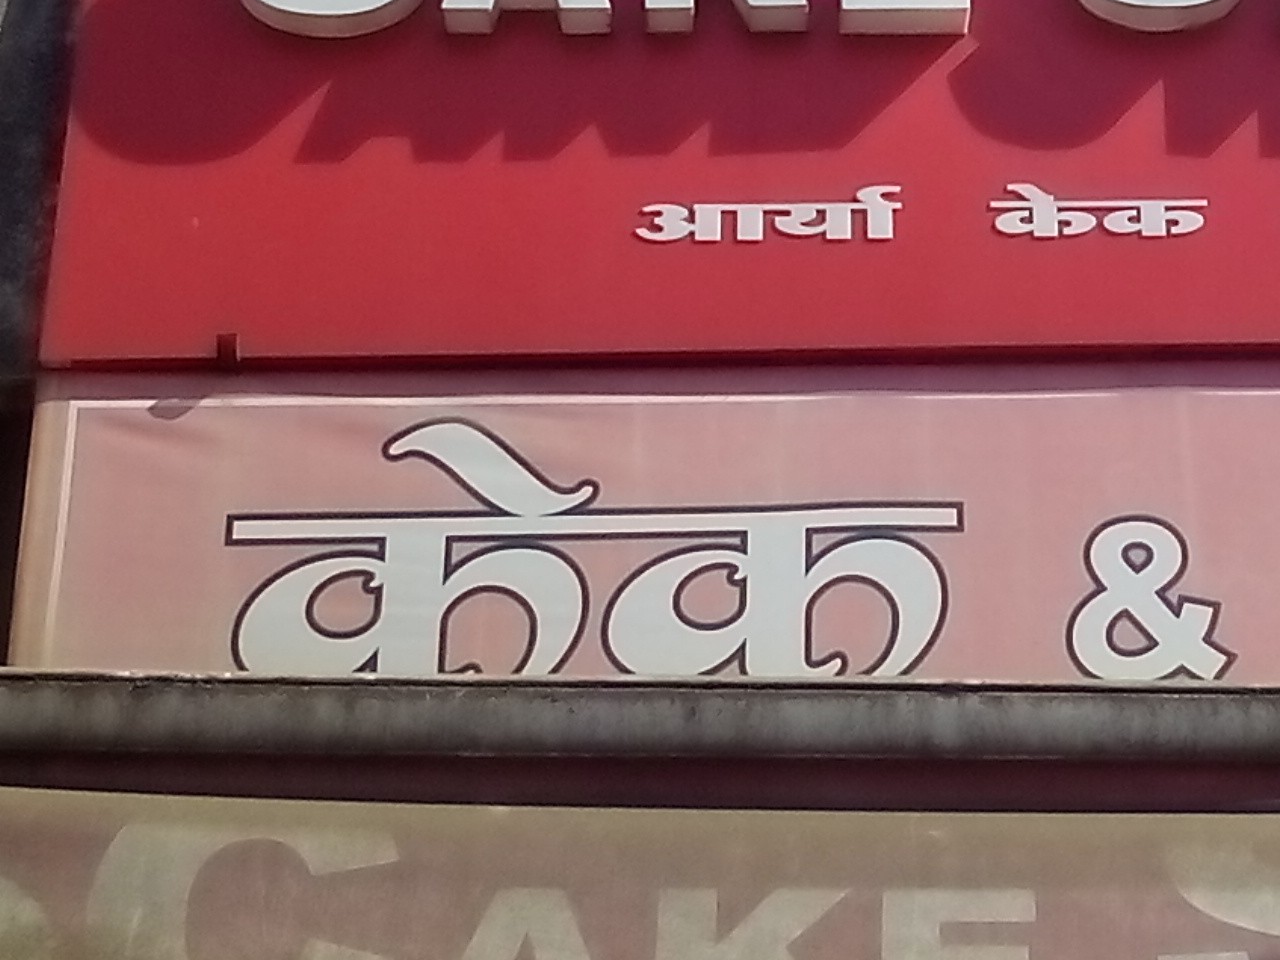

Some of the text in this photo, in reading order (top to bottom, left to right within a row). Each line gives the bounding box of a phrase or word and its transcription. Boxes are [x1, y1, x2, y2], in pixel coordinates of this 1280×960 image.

[634, 184, 903, 244] आर्या
[990, 182, 1208, 240] केक
[225, 417, 965, 676] केक
[1068, 514, 1238, 680] &
